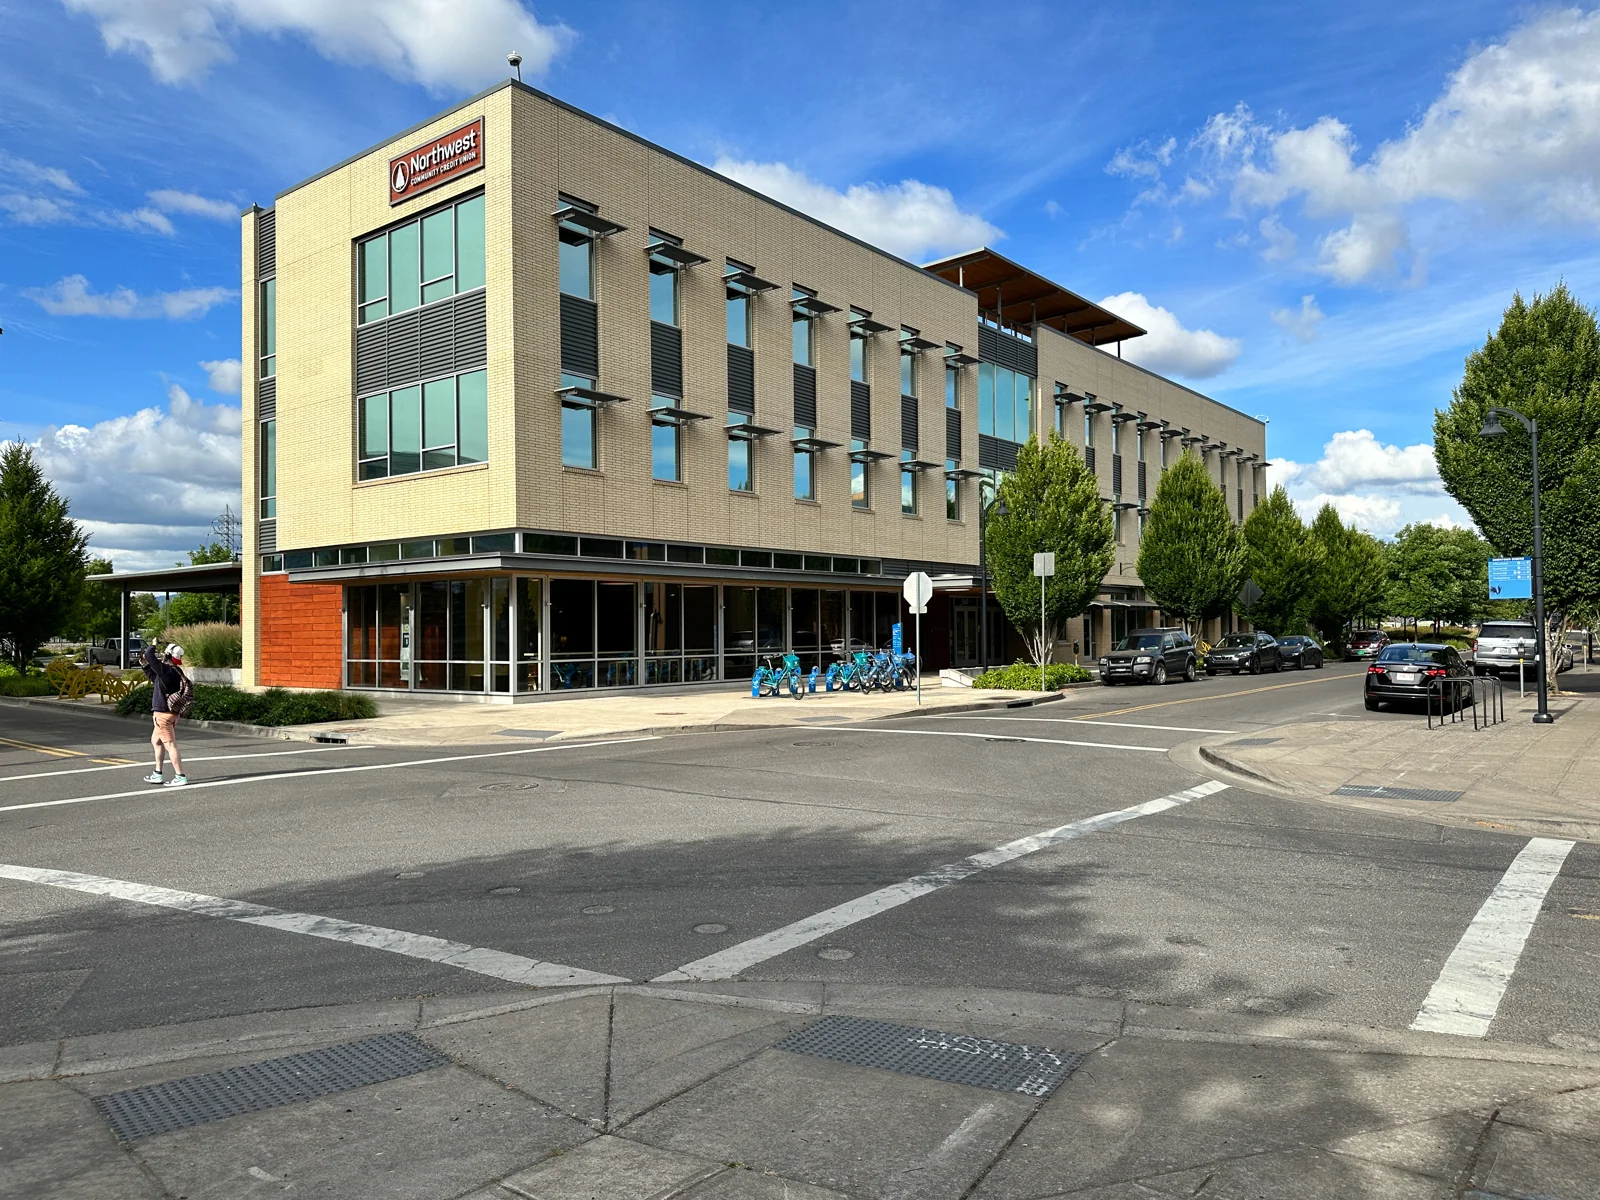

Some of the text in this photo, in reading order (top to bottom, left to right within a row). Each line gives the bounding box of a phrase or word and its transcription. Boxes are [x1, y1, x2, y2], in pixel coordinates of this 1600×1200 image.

[410, 128, 476, 174] Northwest
[410, 151, 476, 186] COMMUNITY CREDIT UNION
